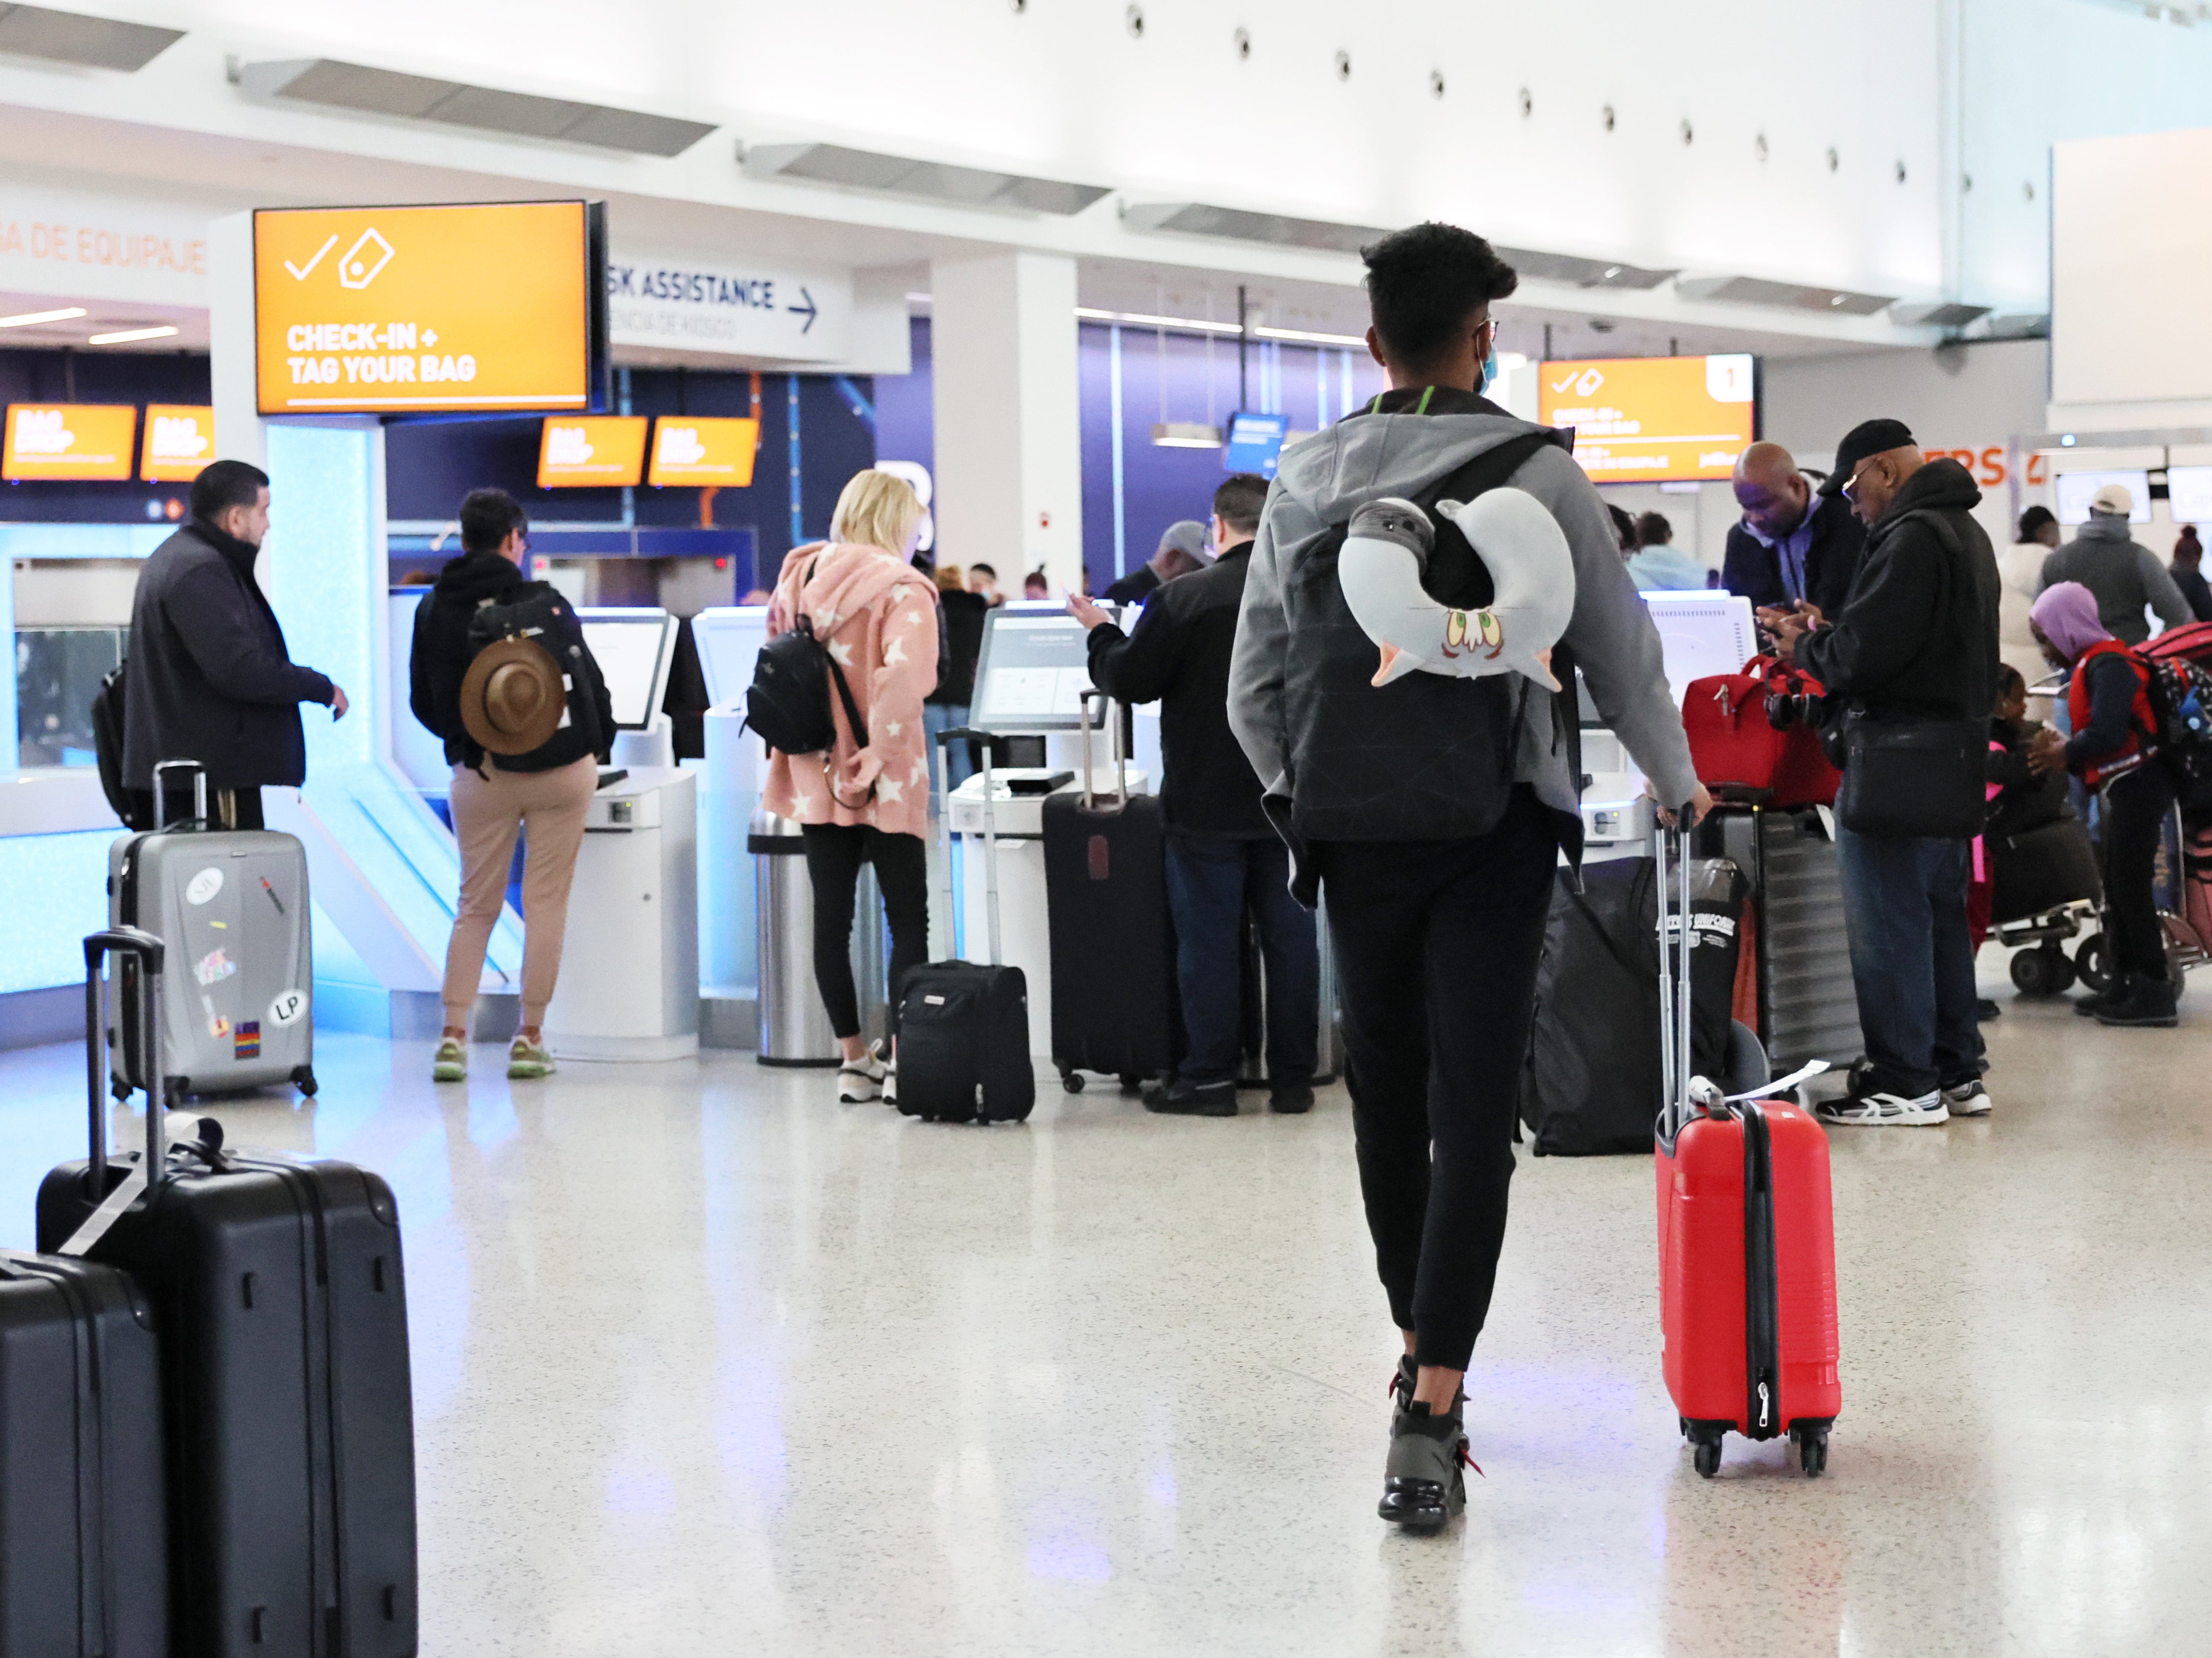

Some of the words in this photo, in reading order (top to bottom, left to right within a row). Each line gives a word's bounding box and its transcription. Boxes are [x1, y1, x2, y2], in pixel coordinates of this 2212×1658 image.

[0, 221, 24, 254] A
[31, 221, 70, 261] DE
[77, 227, 207, 275] EQUIPAJE
[642, 271, 773, 310] ASSISTANCE
[287, 322, 417, 352] CHECK-IN
[287, 356, 340, 384] TAG
[342, 355, 417, 383] YOUR
[420, 354, 476, 382] BAG
[1726, 367, 1735, 389] 1
[276, 996, 299, 1020] LP
